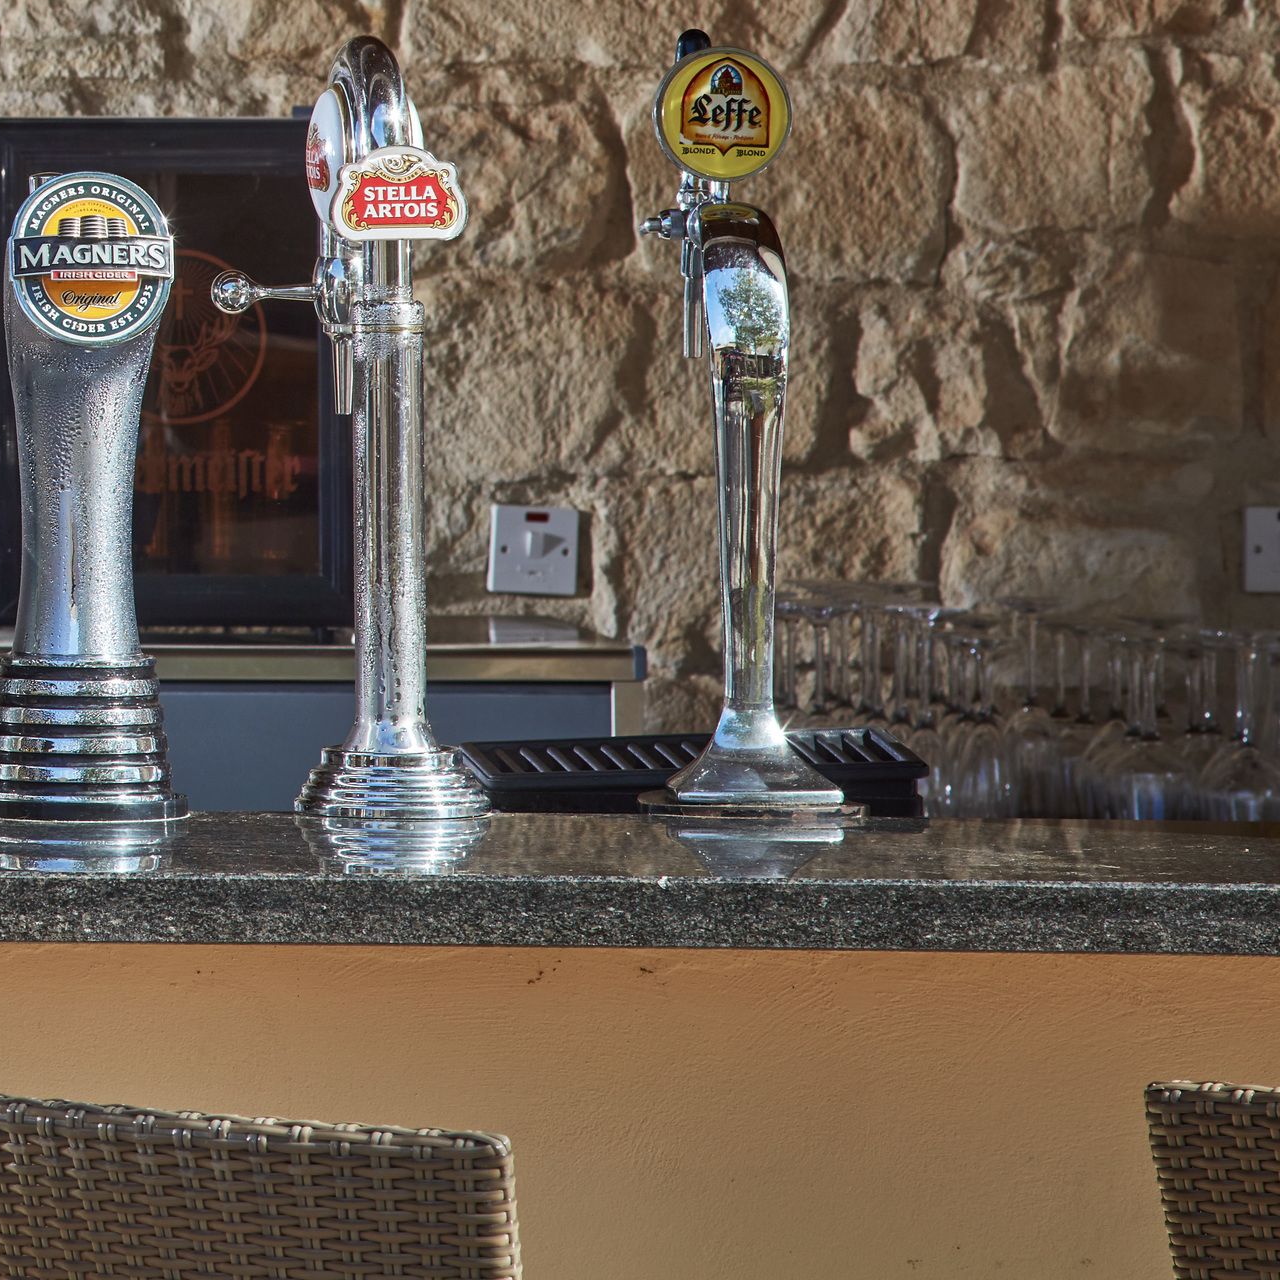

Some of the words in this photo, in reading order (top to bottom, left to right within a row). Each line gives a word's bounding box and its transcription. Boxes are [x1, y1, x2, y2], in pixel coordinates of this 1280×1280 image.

[687, 93, 762, 132] Leffe
[682, 146, 716, 155] BLONDE
[736, 148, 766, 157] BLOND
[379, 172, 395, 182] ANNO
[363, 185, 438, 201] STELLA
[30, 185, 85, 231] MAGNERS
[90, 185, 151, 230] ORIGINAL
[363, 202, 438, 219] ARTOIS
[19, 243, 166, 269] MAGNERS
[31, 285, 60, 321] IRISH
[62, 318, 106, 333] CIDER
[110, 313, 138, 331] EST.
[136, 284, 153, 312] 1935
[61, 290, 122, 312] Original
